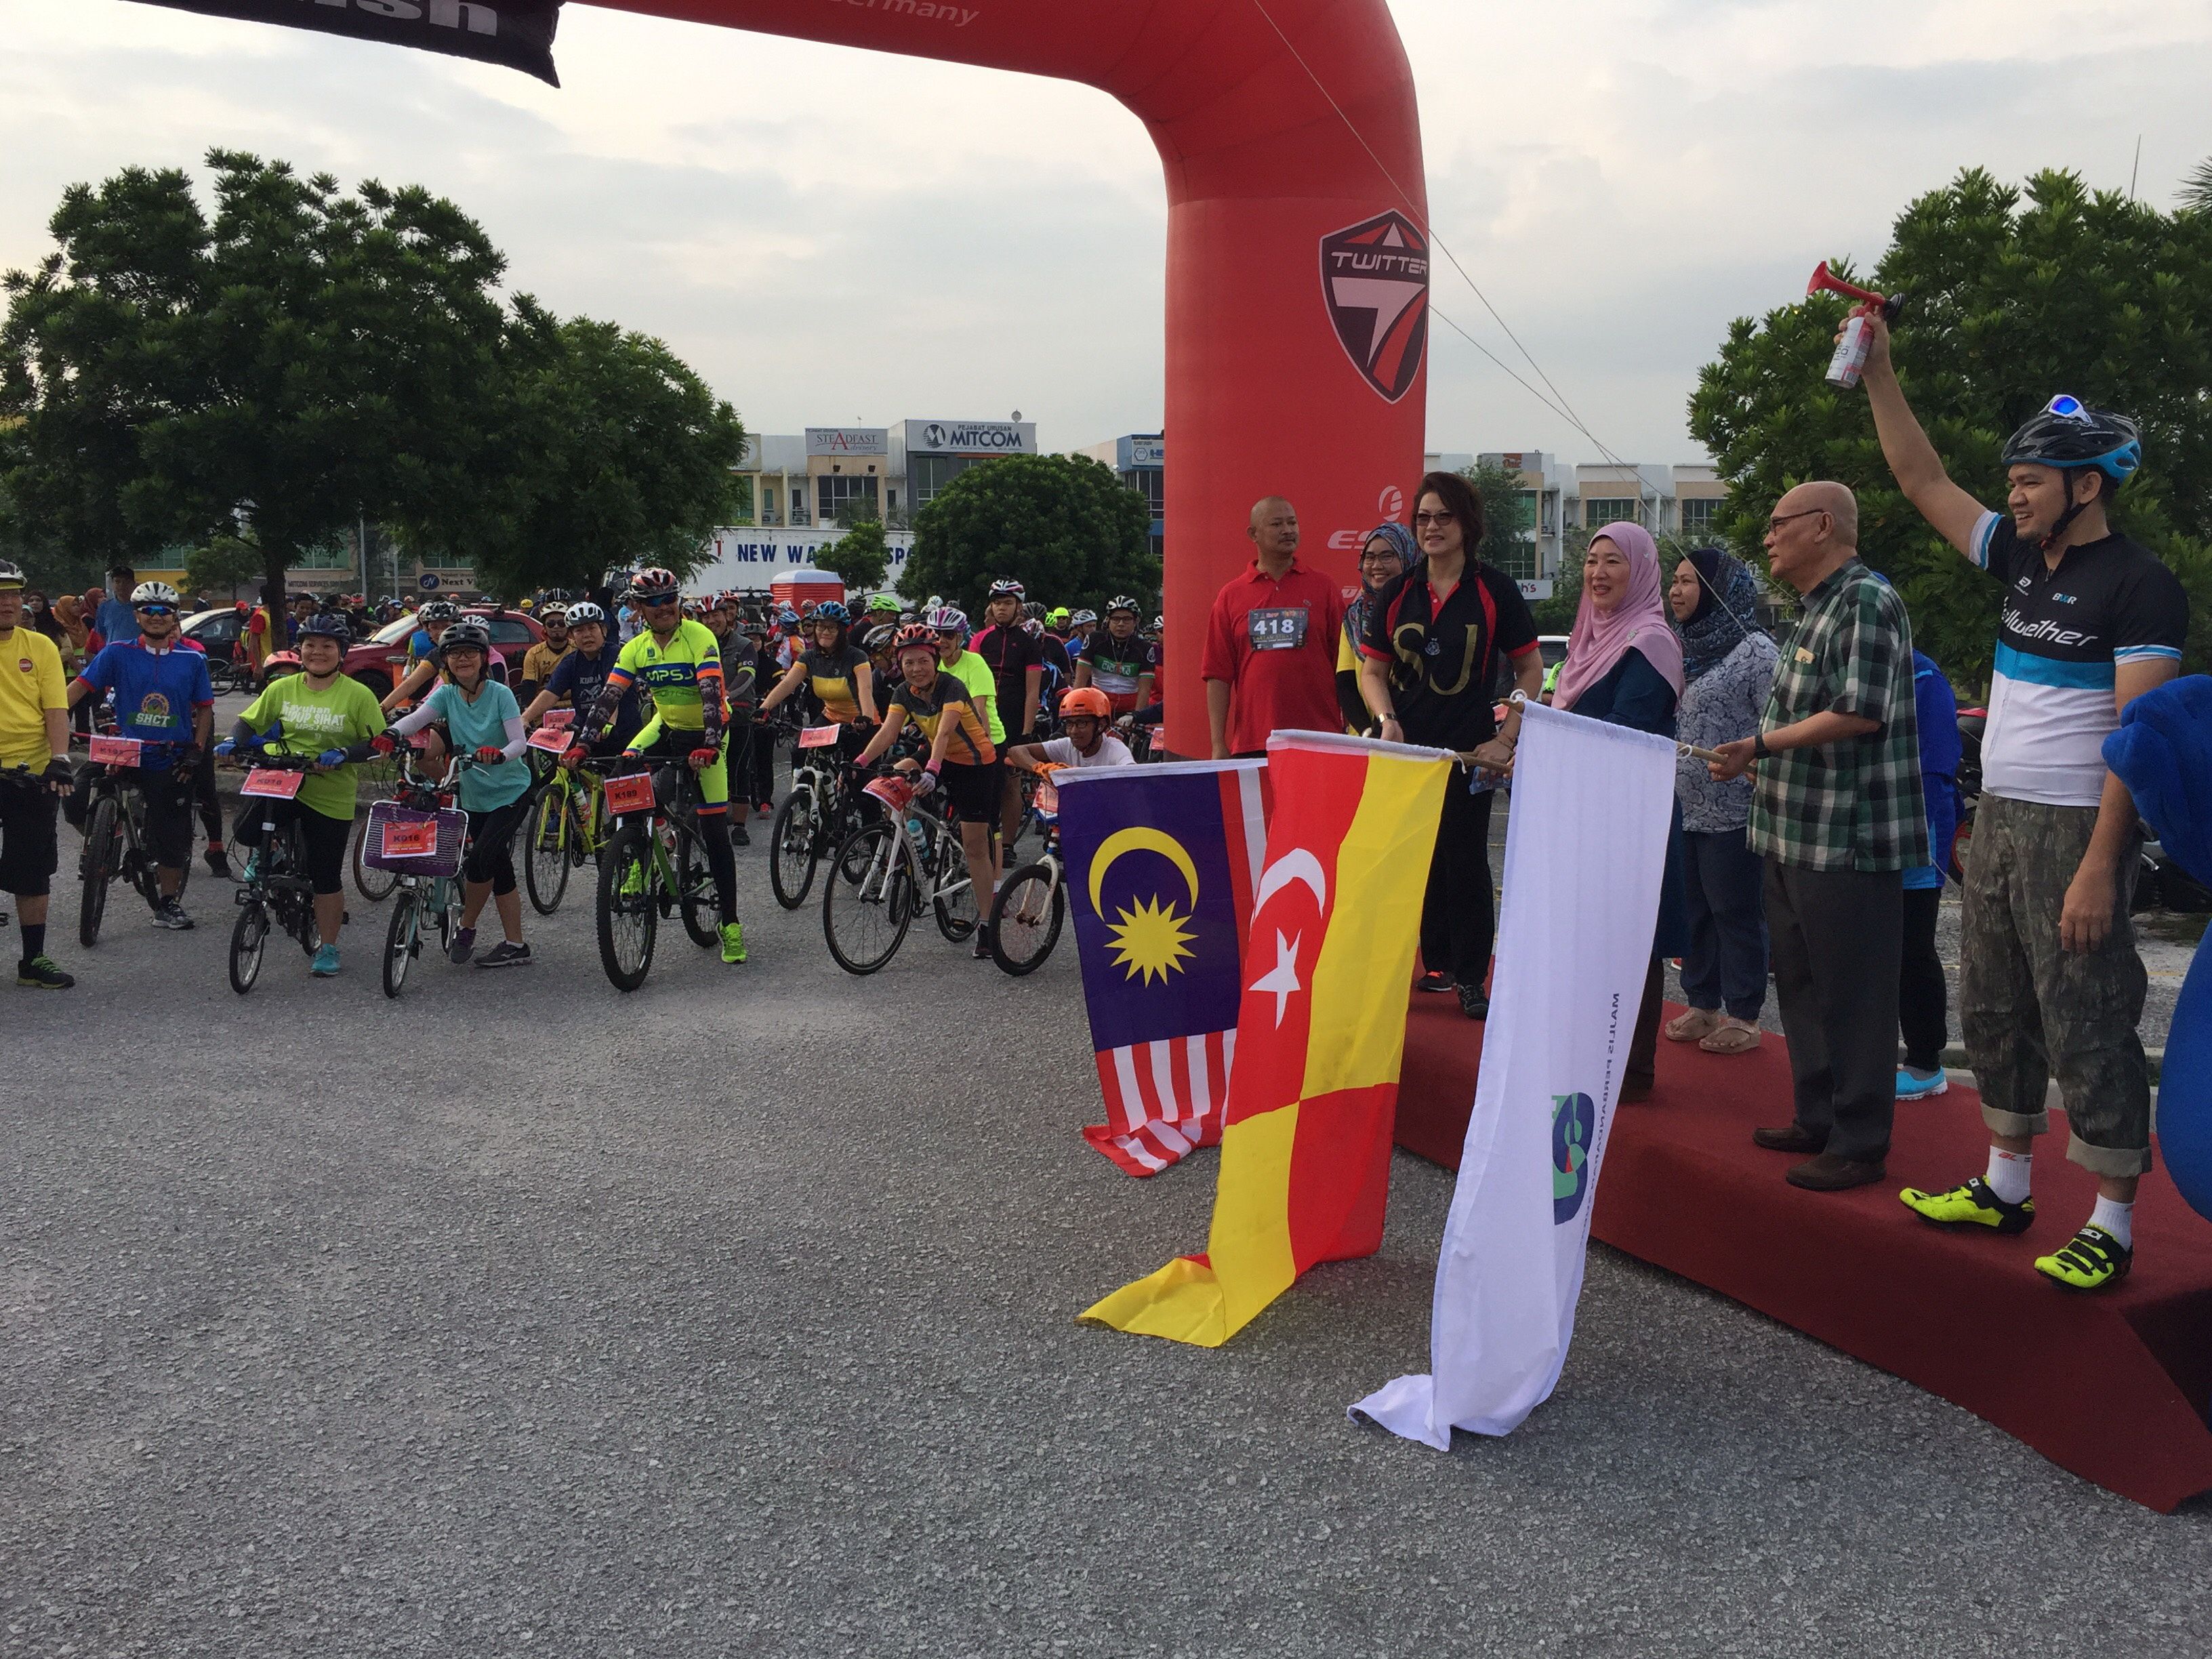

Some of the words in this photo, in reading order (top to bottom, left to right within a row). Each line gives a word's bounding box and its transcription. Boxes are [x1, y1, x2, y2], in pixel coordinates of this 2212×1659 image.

[1331, 251, 1427, 276] TWITTER
[817, 432, 877, 450] STEADFAST
[950, 430, 1022, 447] MITCOM
[737, 544, 777, 562] NEW
[1254, 619, 1294, 635] 418
[136, 713, 171, 727] SHCT
[313, 713, 346, 726] SIHAT
